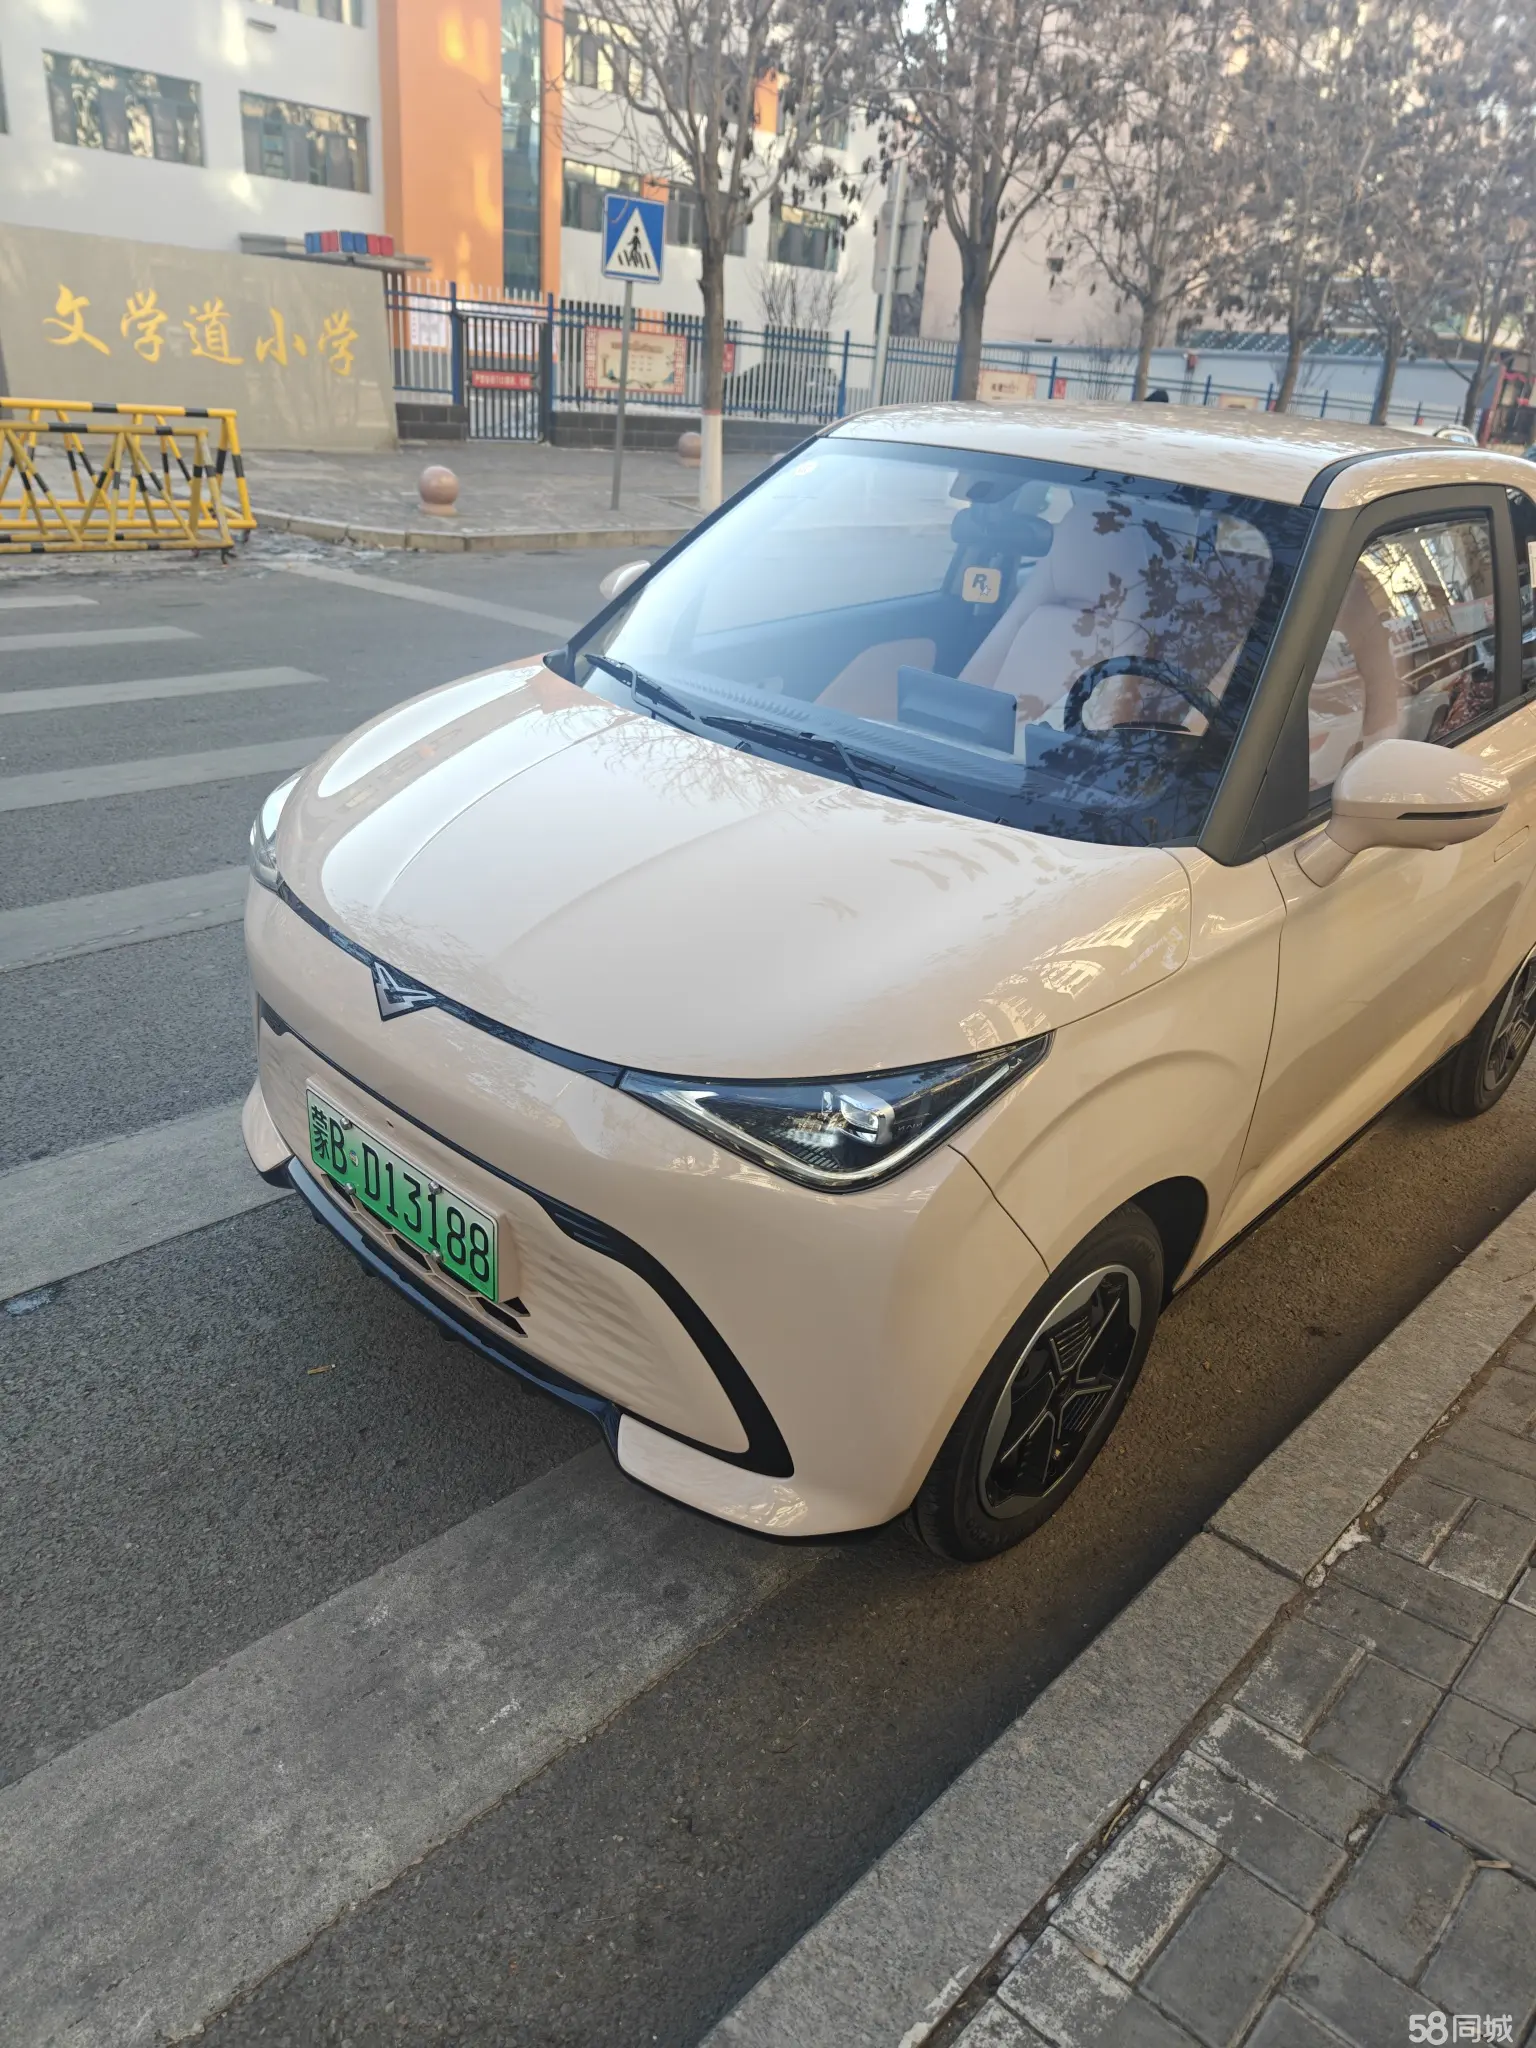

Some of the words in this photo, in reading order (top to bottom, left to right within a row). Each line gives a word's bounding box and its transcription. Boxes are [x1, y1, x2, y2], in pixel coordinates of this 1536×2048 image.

[43, 283, 360, 376] 文学道小学
